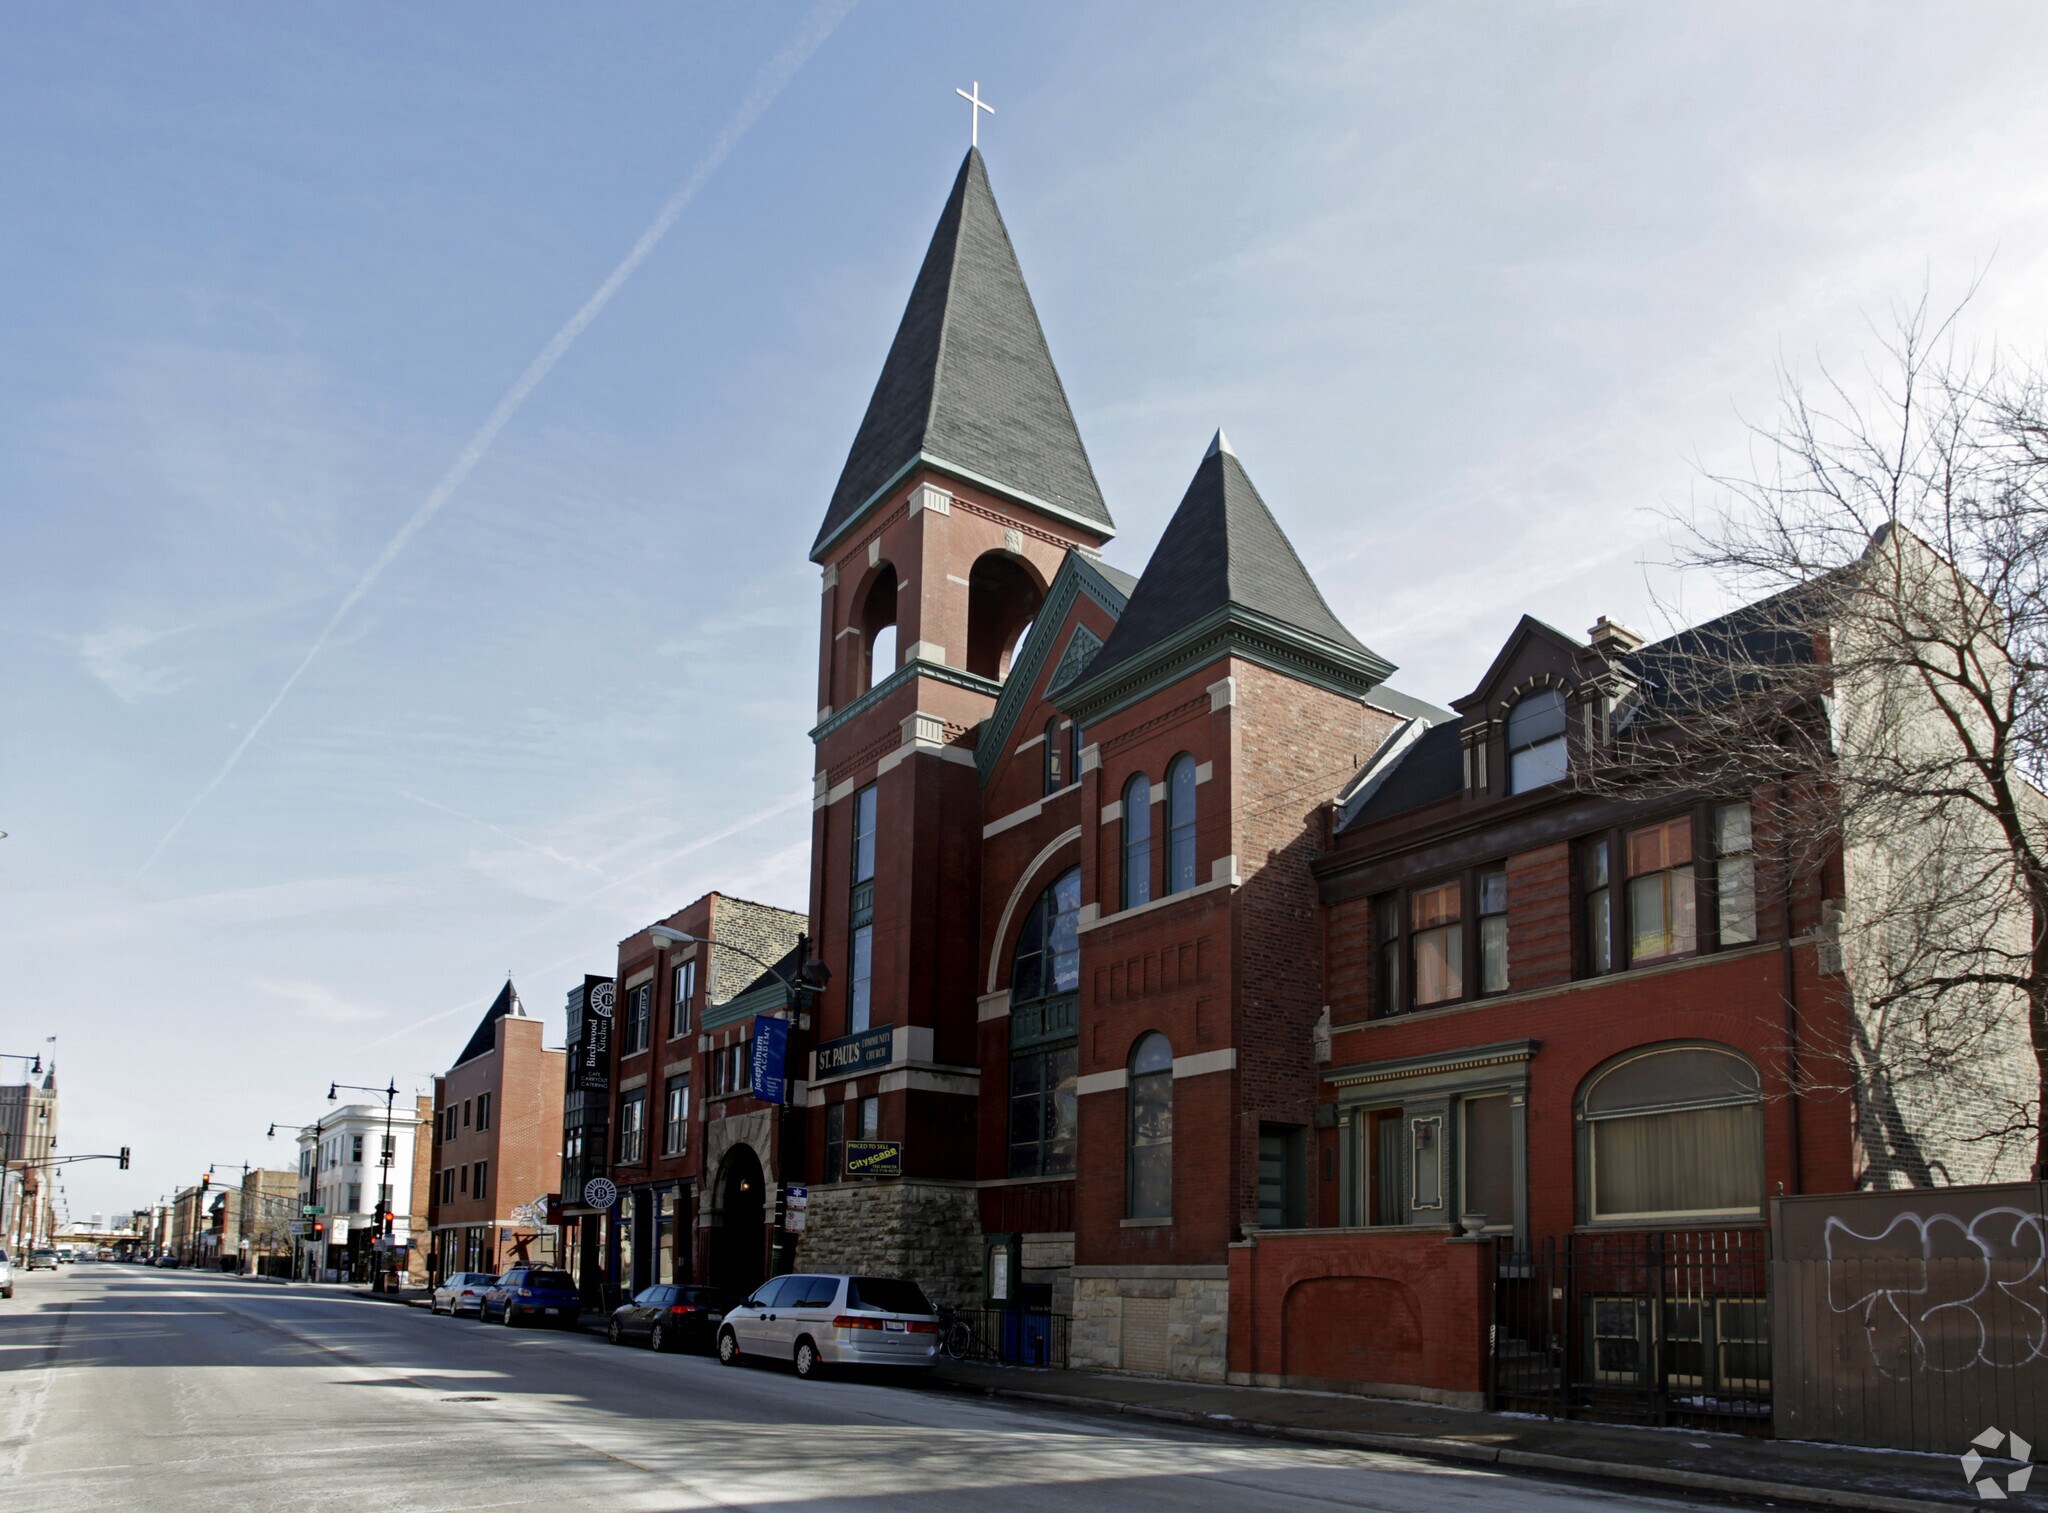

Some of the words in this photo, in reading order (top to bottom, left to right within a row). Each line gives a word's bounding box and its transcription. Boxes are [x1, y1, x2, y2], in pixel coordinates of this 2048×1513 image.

[604, 994, 613, 1006] B
[586, 1019, 598, 1068] Birchwood
[597, 1020, 607, 1053] Kitchen
[761, 1025, 771, 1071] ACADEMY
[862, 1032, 890, 1049] COMMUNITY
[753, 1035, 764, 1093] Josephinum
[819, 1050, 832, 1071] ST.
[833, 1042, 860, 1067] PAUL'S
[866, 1047, 886, 1061] CHURCH
[580, 1081, 608, 1089] CATERING
[848, 1147, 898, 1170] Cityscape
[597, 1188, 605, 1199] B
